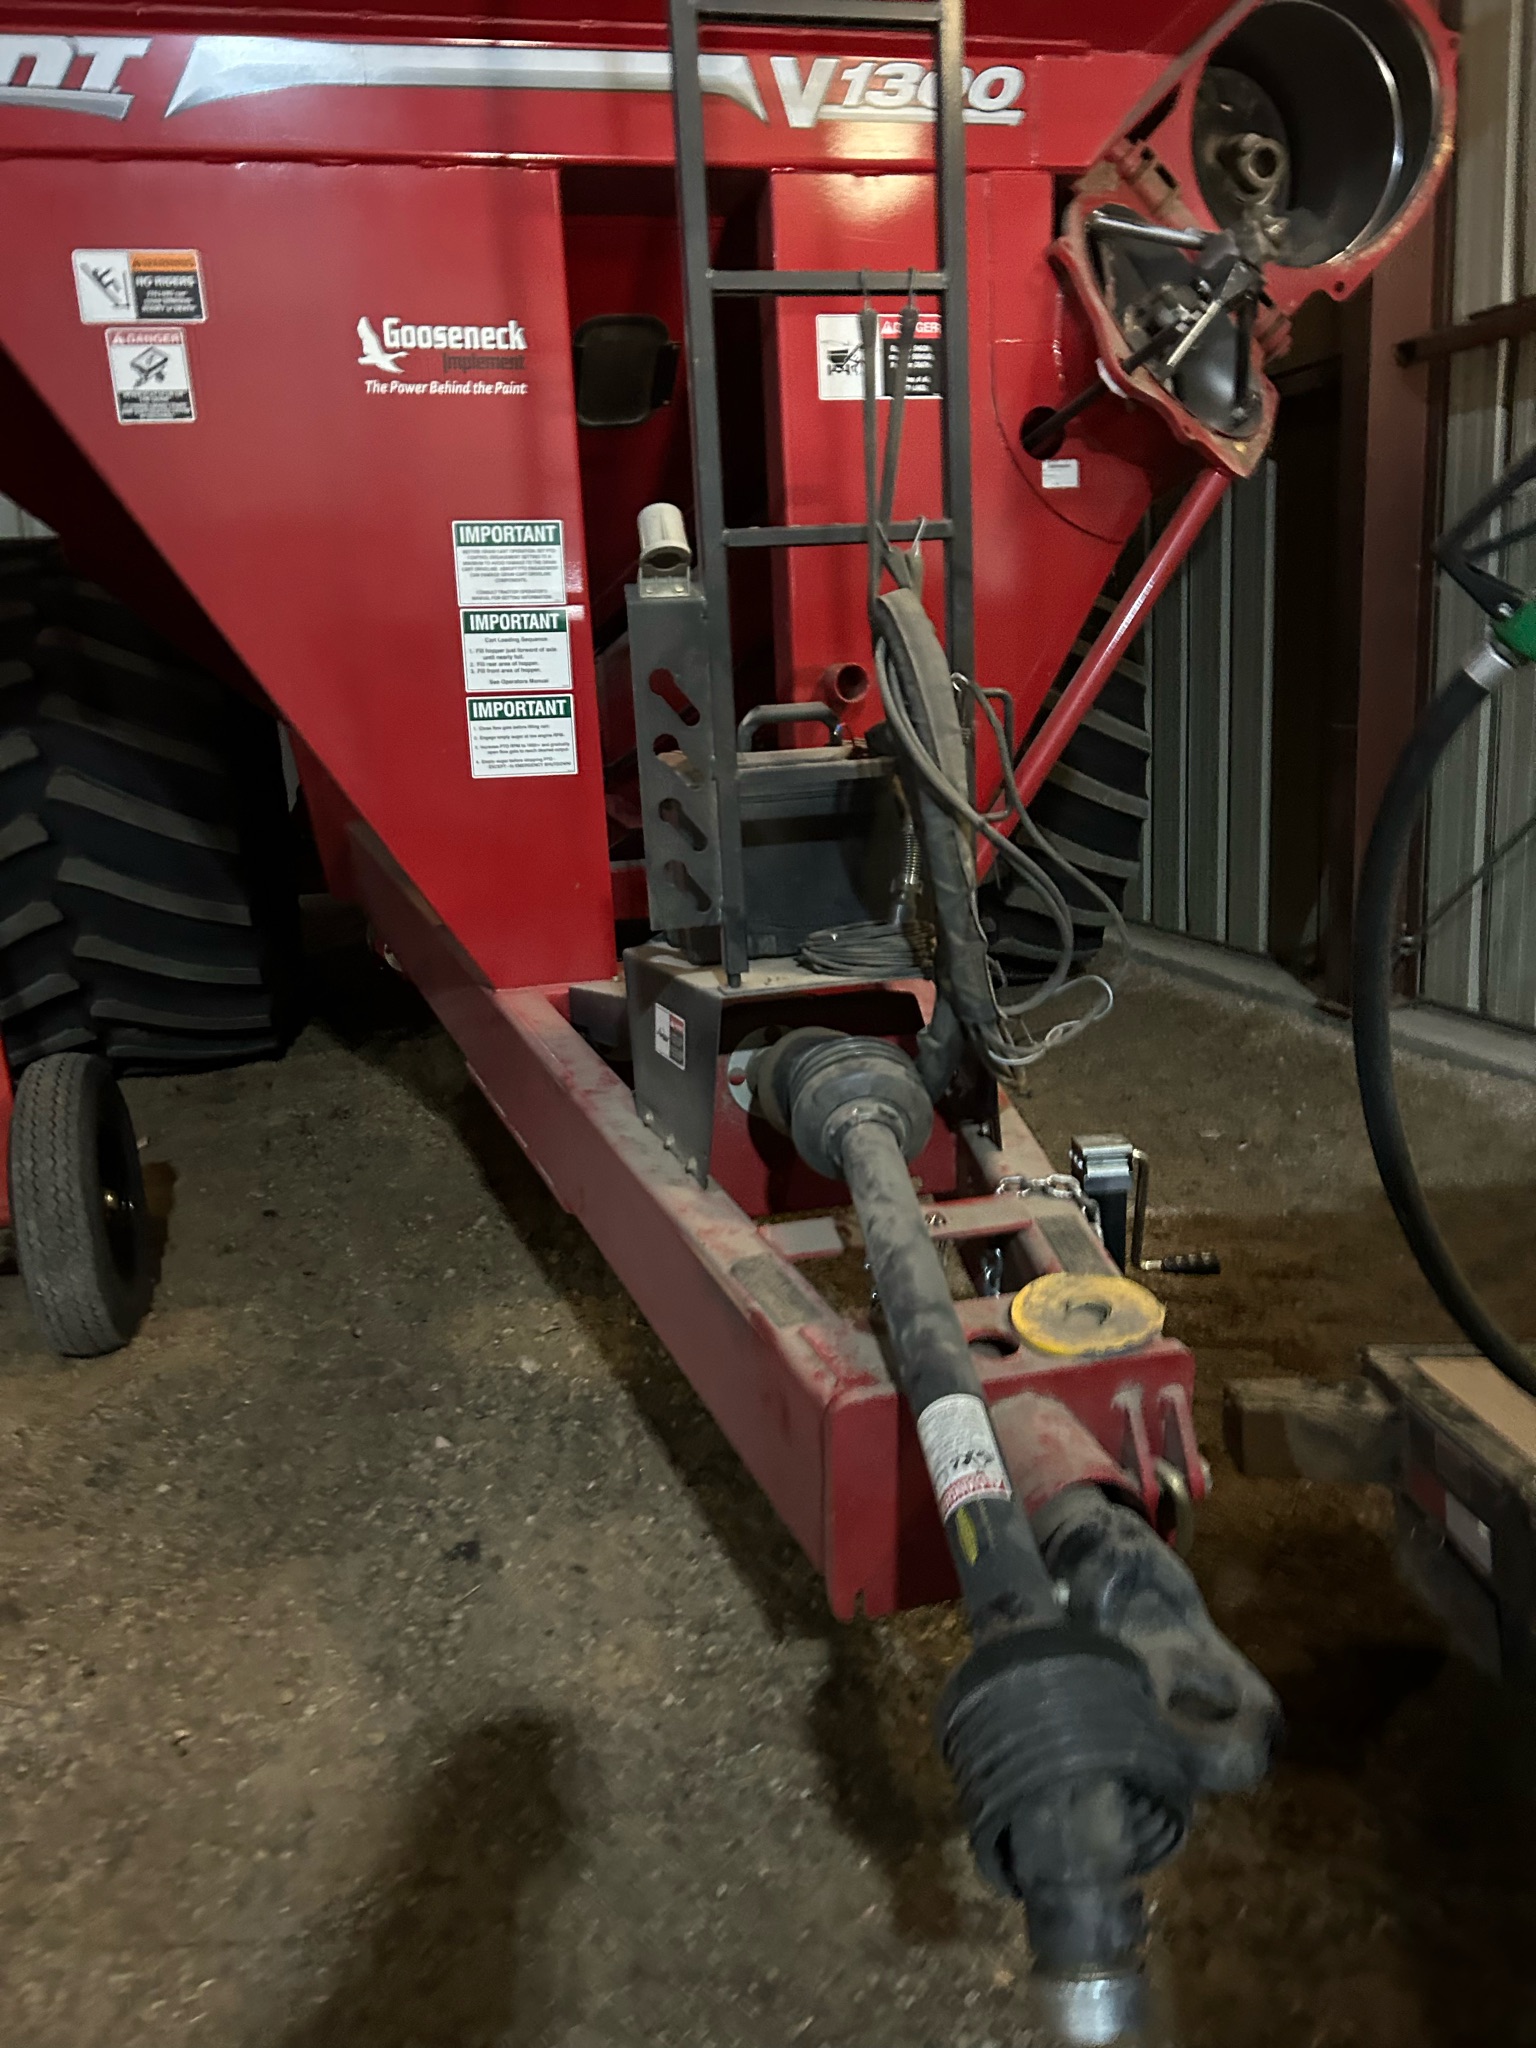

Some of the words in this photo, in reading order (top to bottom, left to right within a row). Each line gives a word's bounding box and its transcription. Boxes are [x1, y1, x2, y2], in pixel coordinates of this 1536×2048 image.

[382, 317, 528, 350] Gooseneck
[365, 379, 388, 394] The
[390, 380, 428, 394] Power
[430, 380, 471, 394] Behind
[473, 380, 494, 394] the
[495, 381, 527, 395] Paint
[459, 525, 558, 544] IMPORTANT
[470, 613, 560, 630] IMPORTANT
[472, 700, 567, 718] IMPORTANT
